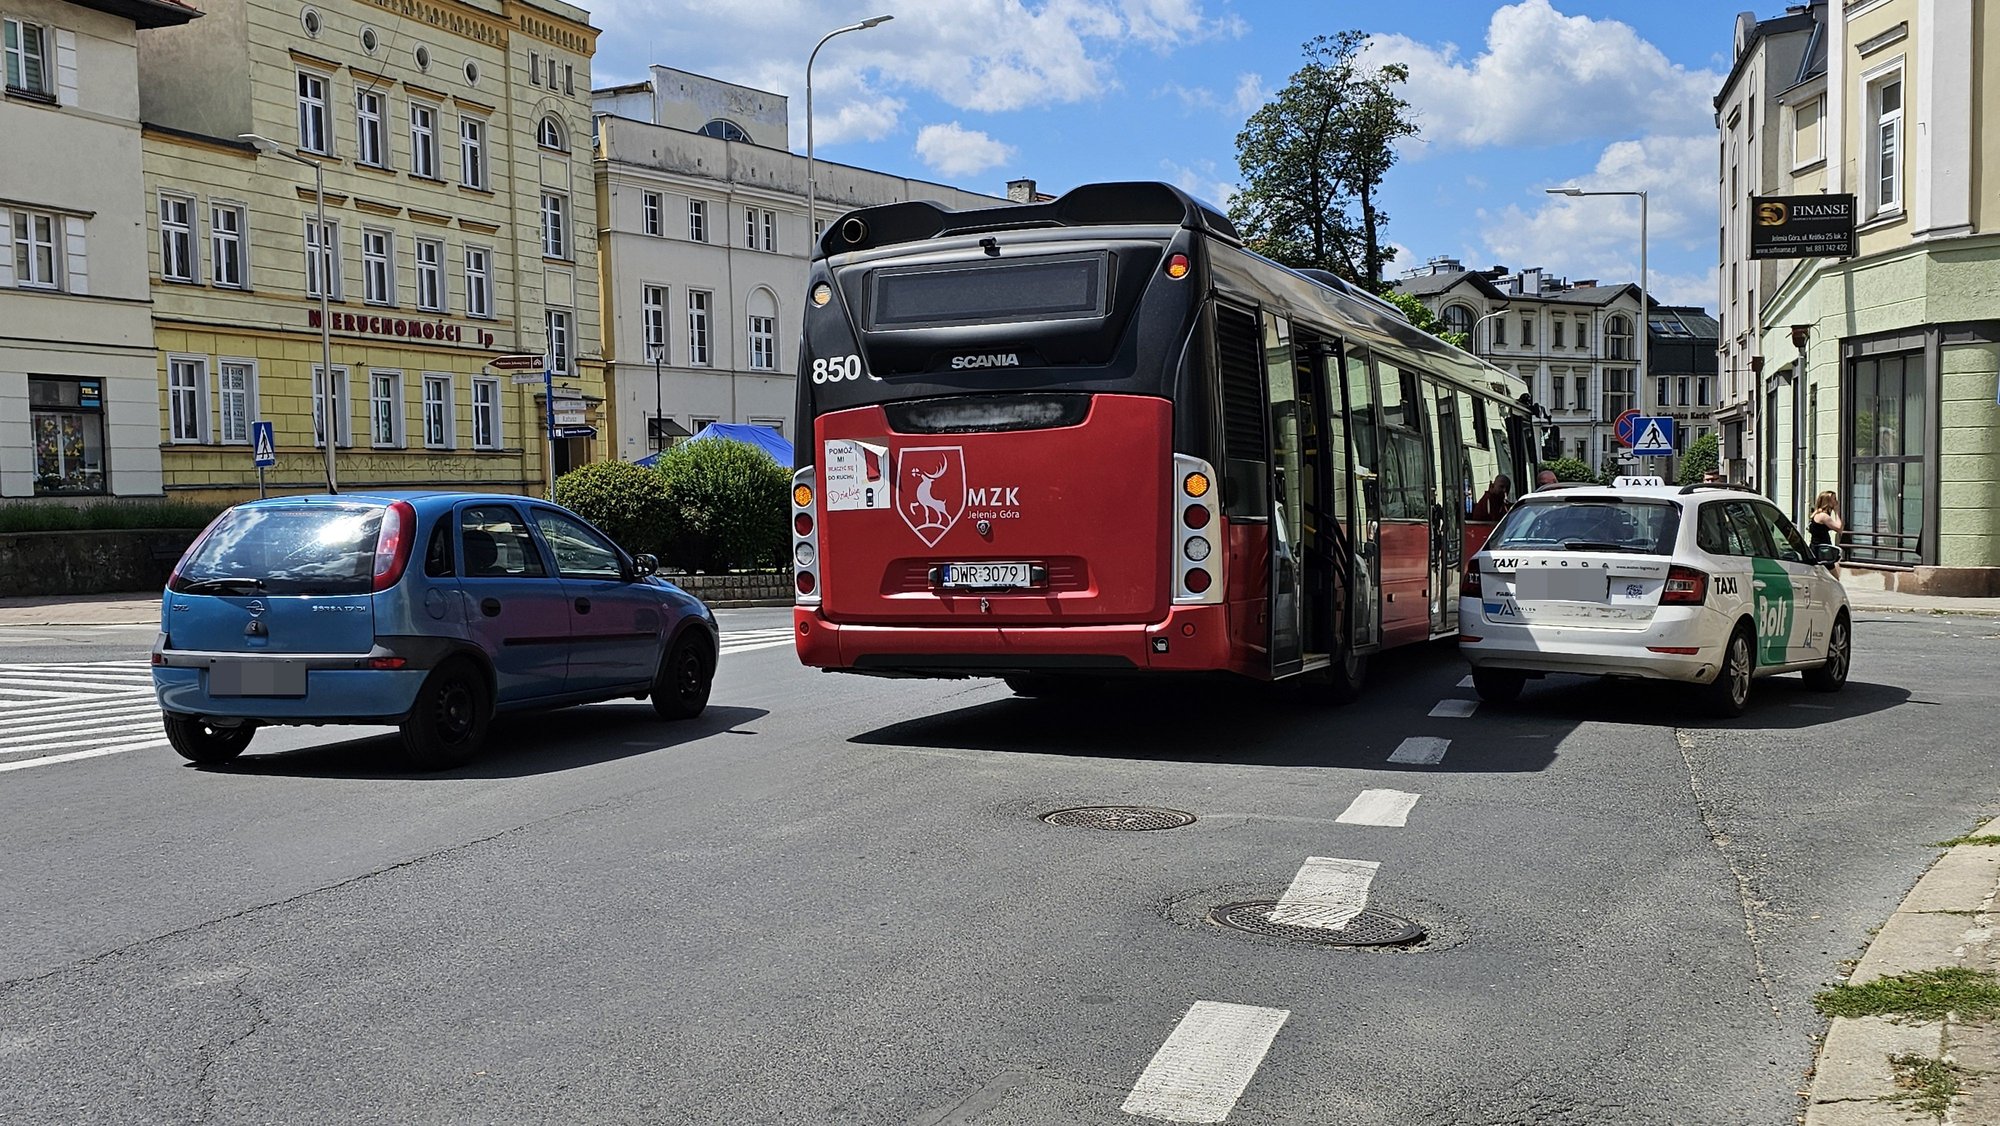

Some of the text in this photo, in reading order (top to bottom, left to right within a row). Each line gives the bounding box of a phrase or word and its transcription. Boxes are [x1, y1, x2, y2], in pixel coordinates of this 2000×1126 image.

[1792, 204, 1849, 216] FINANSE
[812, 354, 862, 385] 850
[951, 353, 1020, 370] SCANIA
[828, 447, 853, 455] POMÓŻ
[1623, 478, 1658, 486] TAXI
[967, 487, 1020, 507] MZK
[967, 510, 1020, 519] Jelenia Góra
[1493, 558, 1519, 568] TAXI
[951, 566, 1027, 583] DWR 3079J
[1714, 577, 1738, 595] TAXI
[1760, 596, 1788, 637] Bolt
